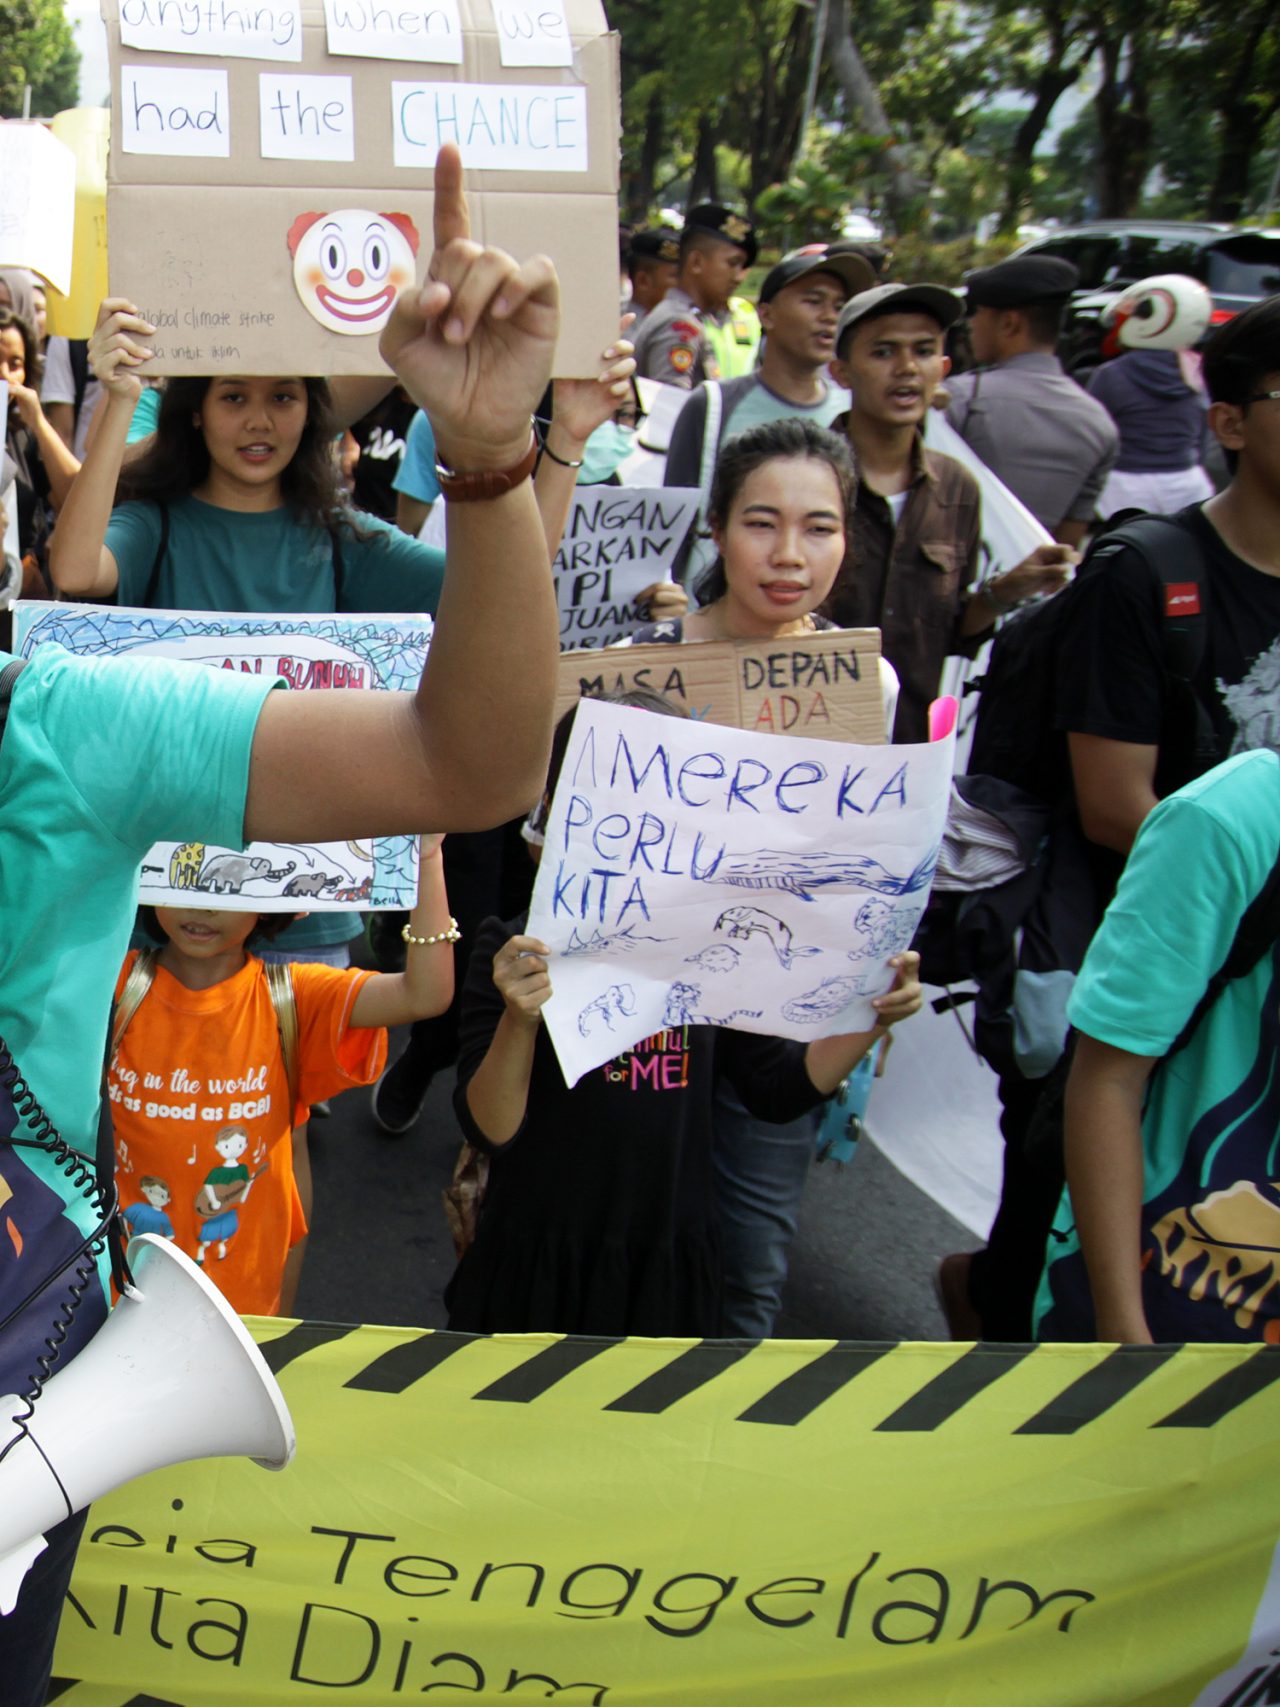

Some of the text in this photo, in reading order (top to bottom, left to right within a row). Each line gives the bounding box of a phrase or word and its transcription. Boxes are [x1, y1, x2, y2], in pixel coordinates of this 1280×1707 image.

[501, 10, 564, 40] we
[133, 80, 576, 149] had the CHANCE
[563, 499, 686, 539] NGAN
[742, 649, 862, 692] DEPAN
[754, 691, 832, 735] ADA
[552, 858, 651, 927] KITA
[170, 1068, 201, 1095] the
[208, 1065, 268, 1094] world
[603, 1064, 629, 1082] for
[630, 1052, 689, 1091] ME!
[145, 1102, 196, 1120] good
[201, 1106, 224, 1121] as
[310, 1526, 1096, 1647] Tenggelam
